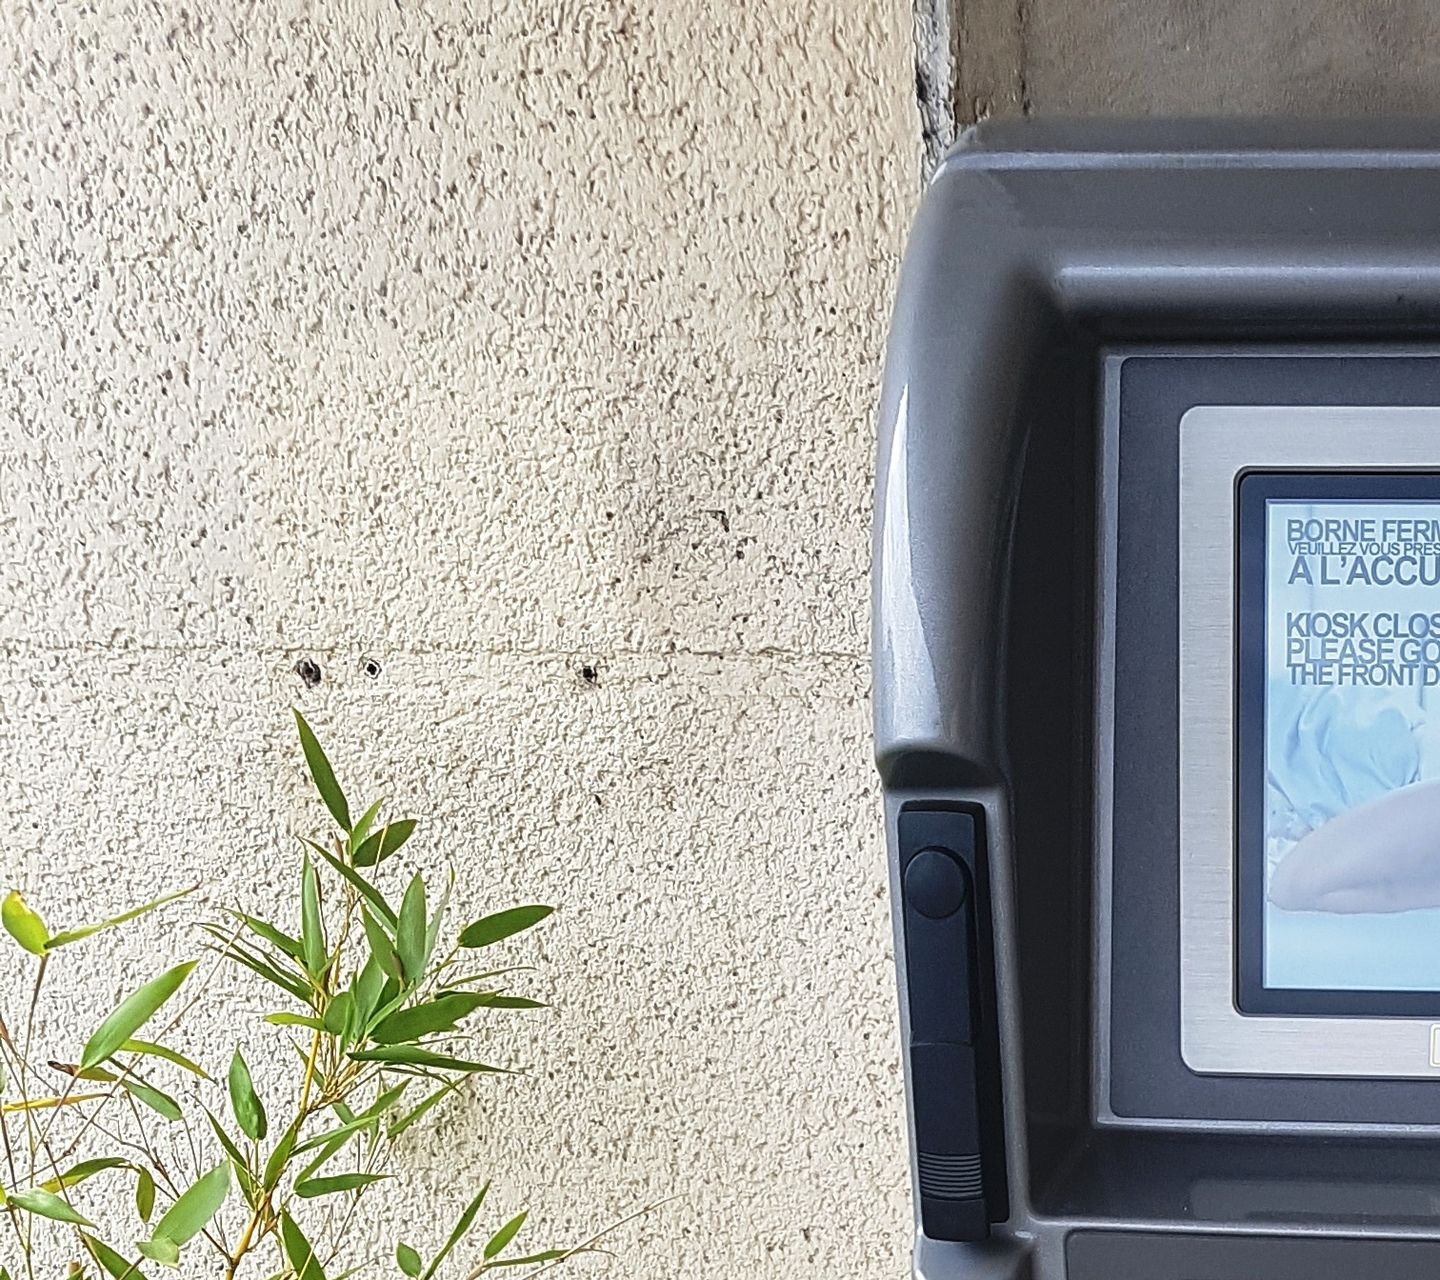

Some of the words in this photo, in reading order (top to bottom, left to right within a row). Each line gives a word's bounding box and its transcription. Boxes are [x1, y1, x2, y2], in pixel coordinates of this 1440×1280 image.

[1286, 519, 1376, 542] BORNE
[1288, 542, 1357, 556] VEUILLEZ
[1359, 542, 1400, 556] VOUS
[1287, 556, 1314, 586] A
[1286, 612, 1370, 639] KIOSK
[1286, 638, 1395, 665] PLEASE
[1289, 664, 1333, 687] THE
[1339, 664, 1419, 687] FRONT
